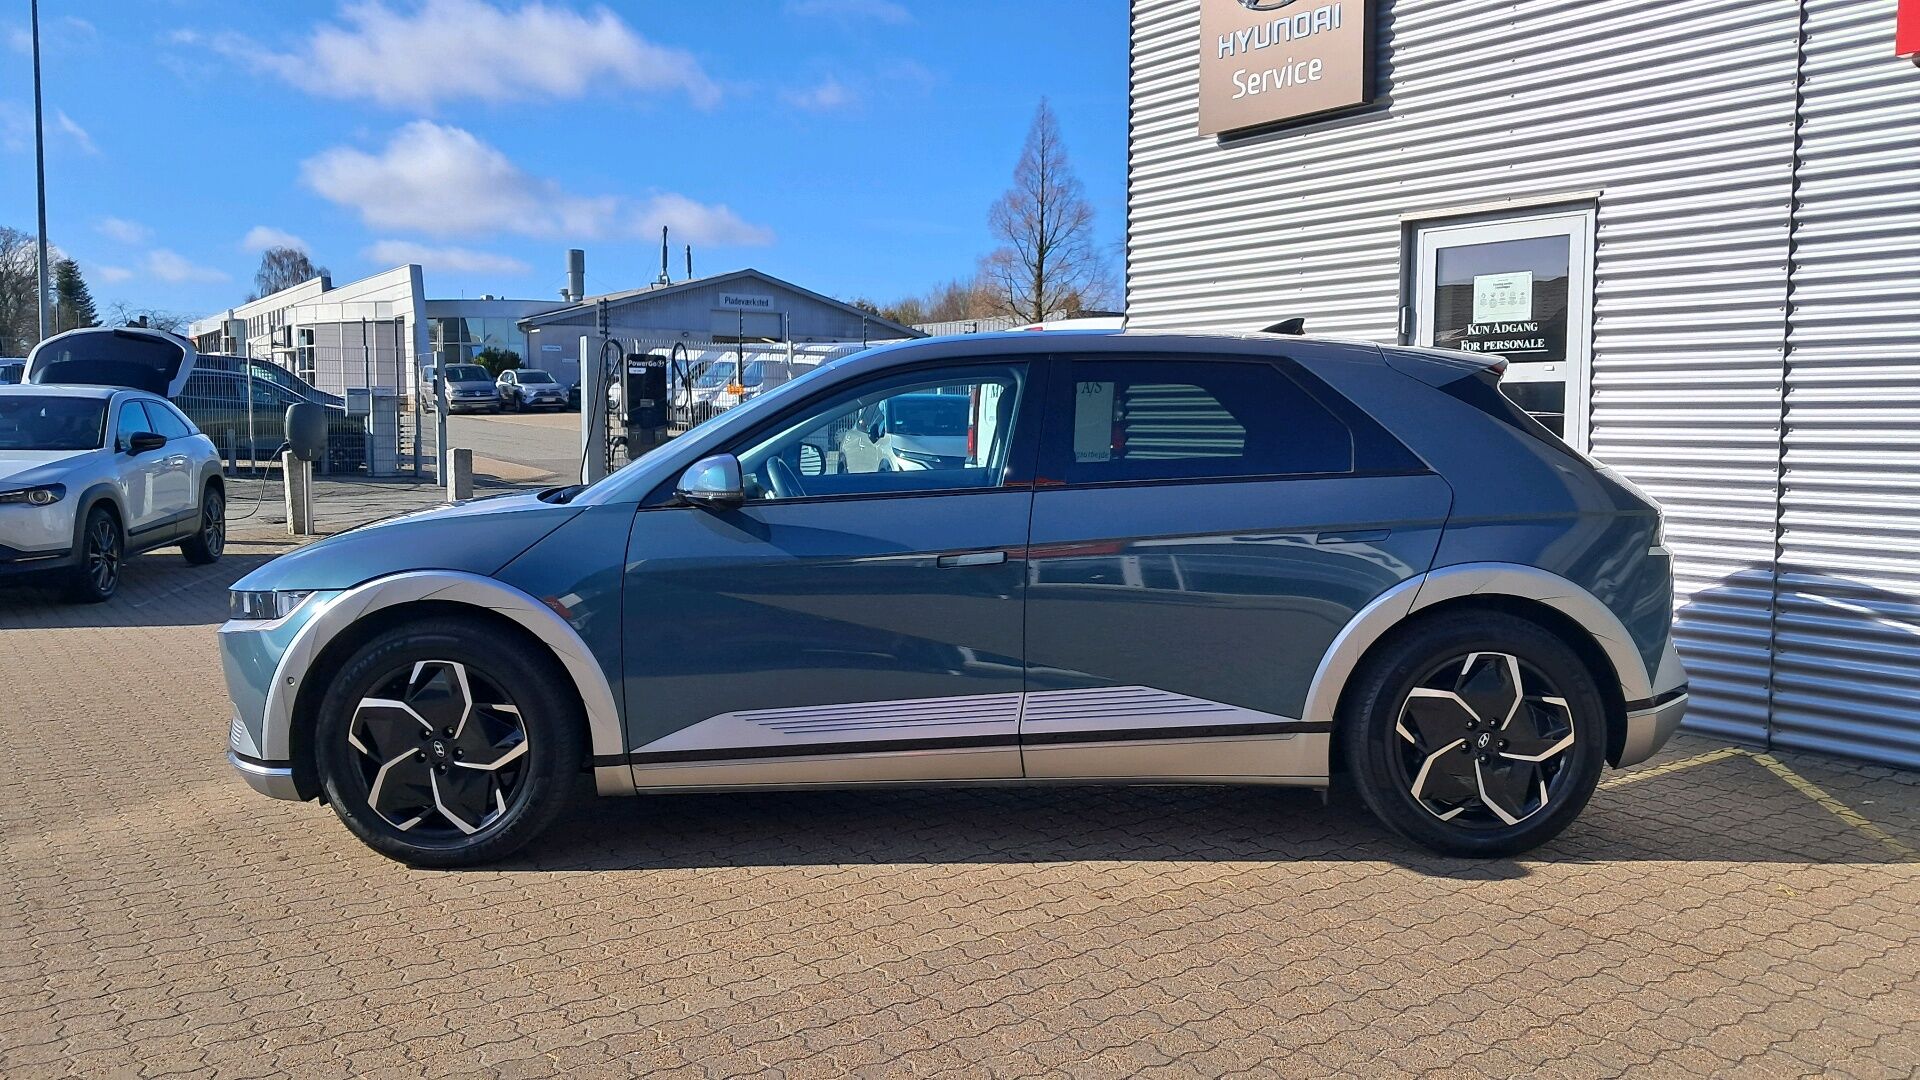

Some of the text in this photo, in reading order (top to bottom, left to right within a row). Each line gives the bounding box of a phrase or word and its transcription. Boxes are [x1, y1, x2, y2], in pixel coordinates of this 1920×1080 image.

[1218, 2, 1341, 59] HYUNDAI
[1232, 57, 1323, 100] Service
[724, 296, 769, 307] Pladeværksted
